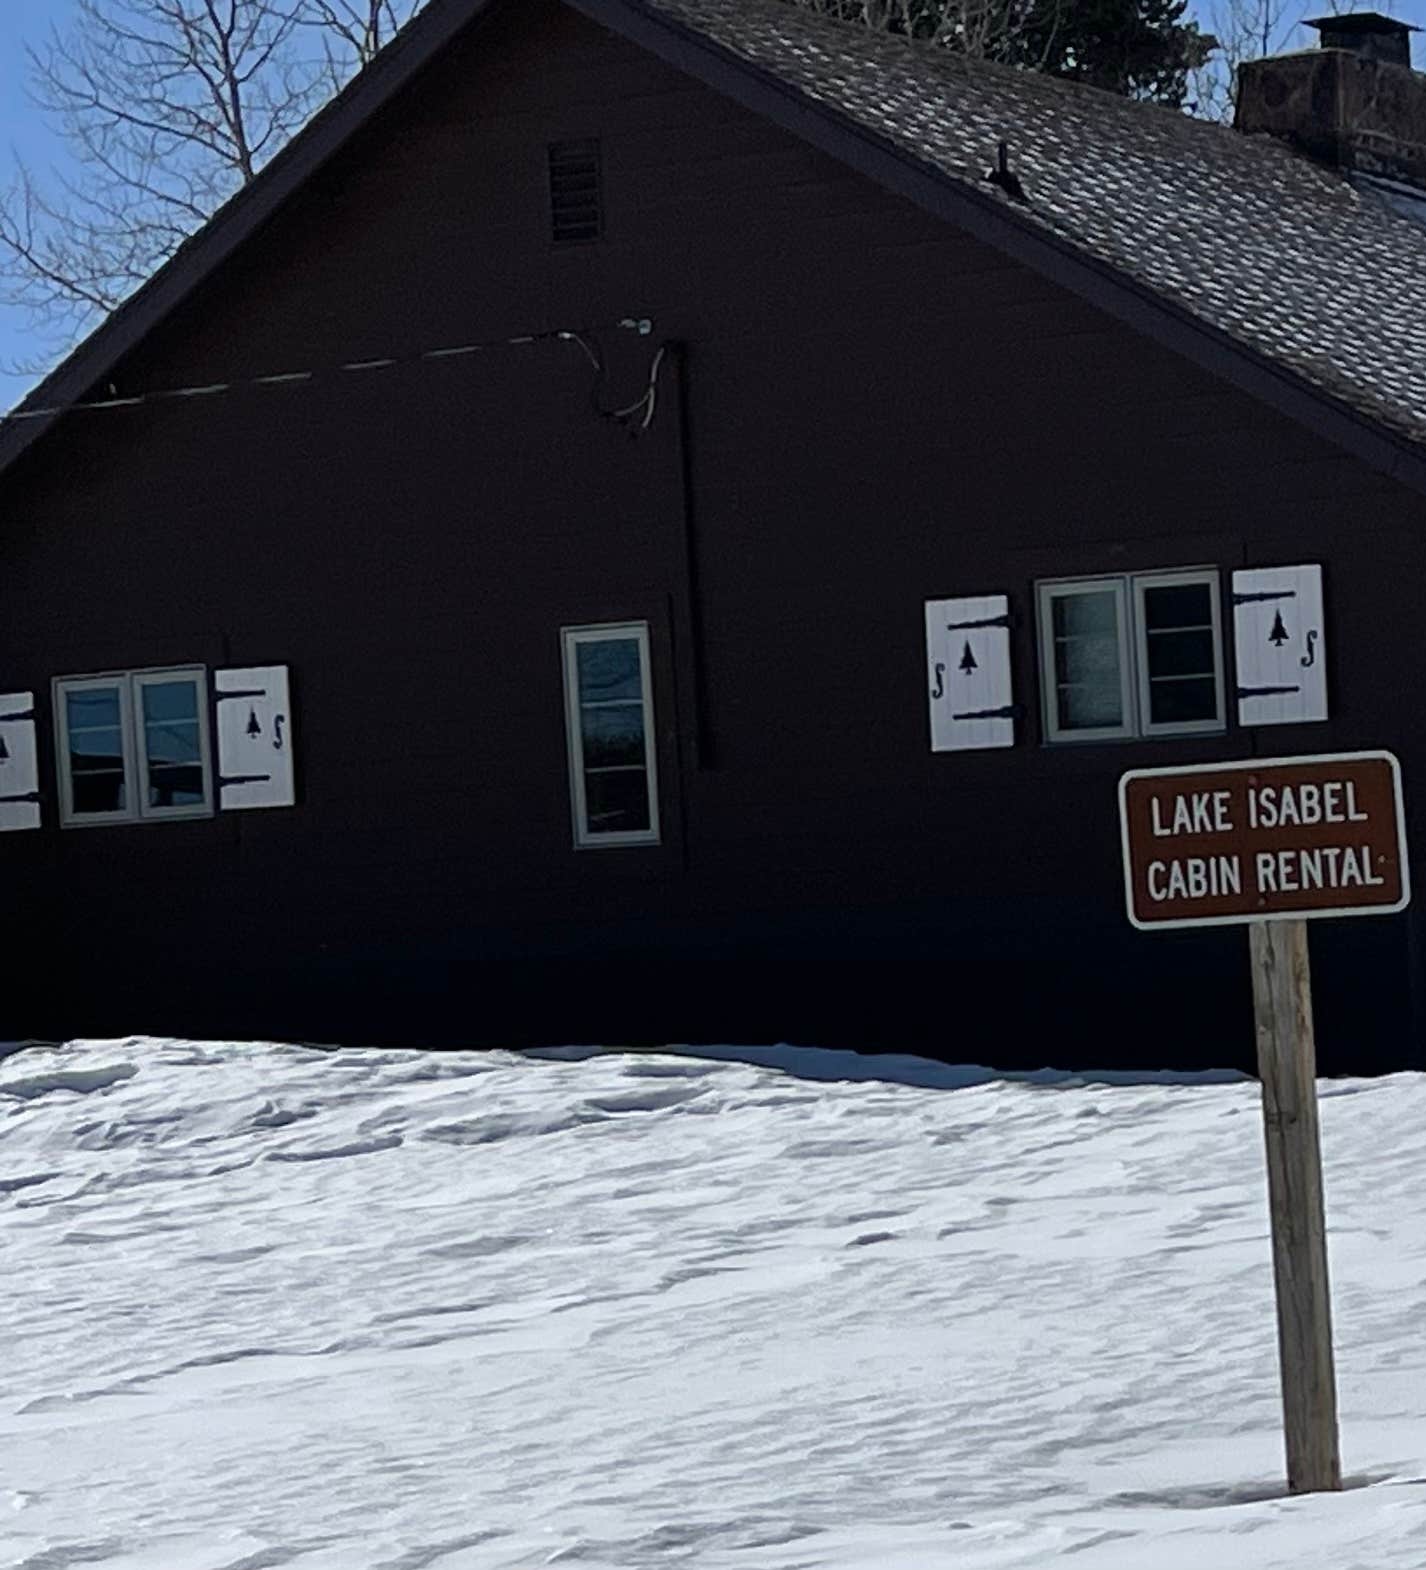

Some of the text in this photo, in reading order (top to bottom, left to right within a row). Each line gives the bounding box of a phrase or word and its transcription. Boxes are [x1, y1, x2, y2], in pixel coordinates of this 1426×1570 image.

[1151, 781, 1368, 836] LAKE ISABEL
[1148, 846, 1384, 901] CABIN RENTAL
